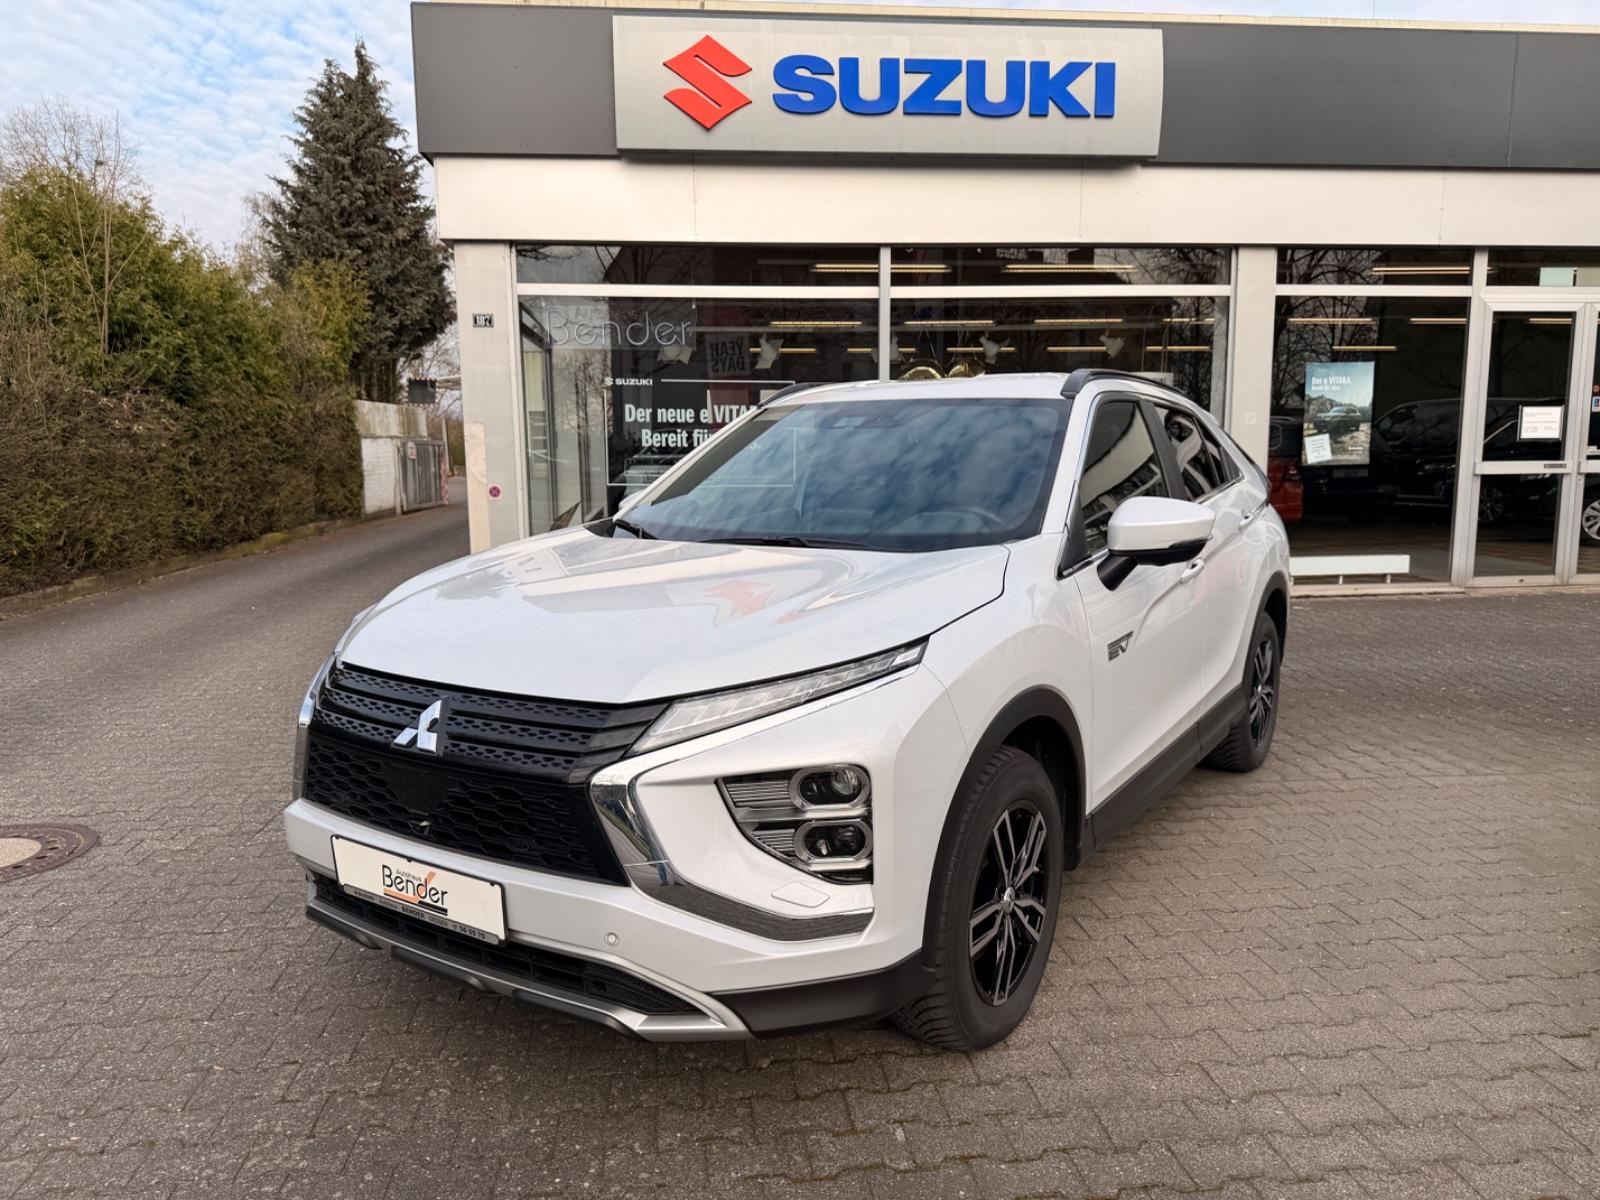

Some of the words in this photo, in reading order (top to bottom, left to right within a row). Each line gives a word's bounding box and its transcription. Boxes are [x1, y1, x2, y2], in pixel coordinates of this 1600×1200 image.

[773, 54, 1116, 118] SUZUKI
[546, 309, 692, 346] Bender
[614, 378, 653, 386] SUZUKI
[624, 403, 653, 422] Der
[657, 407, 695, 423] neue
[700, 408, 709, 424] e
[713, 404, 757, 423] VITA
[641, 428, 689, 448] Bereit
[692, 429, 713, 447] fü
[381, 864, 448, 906] Bender
